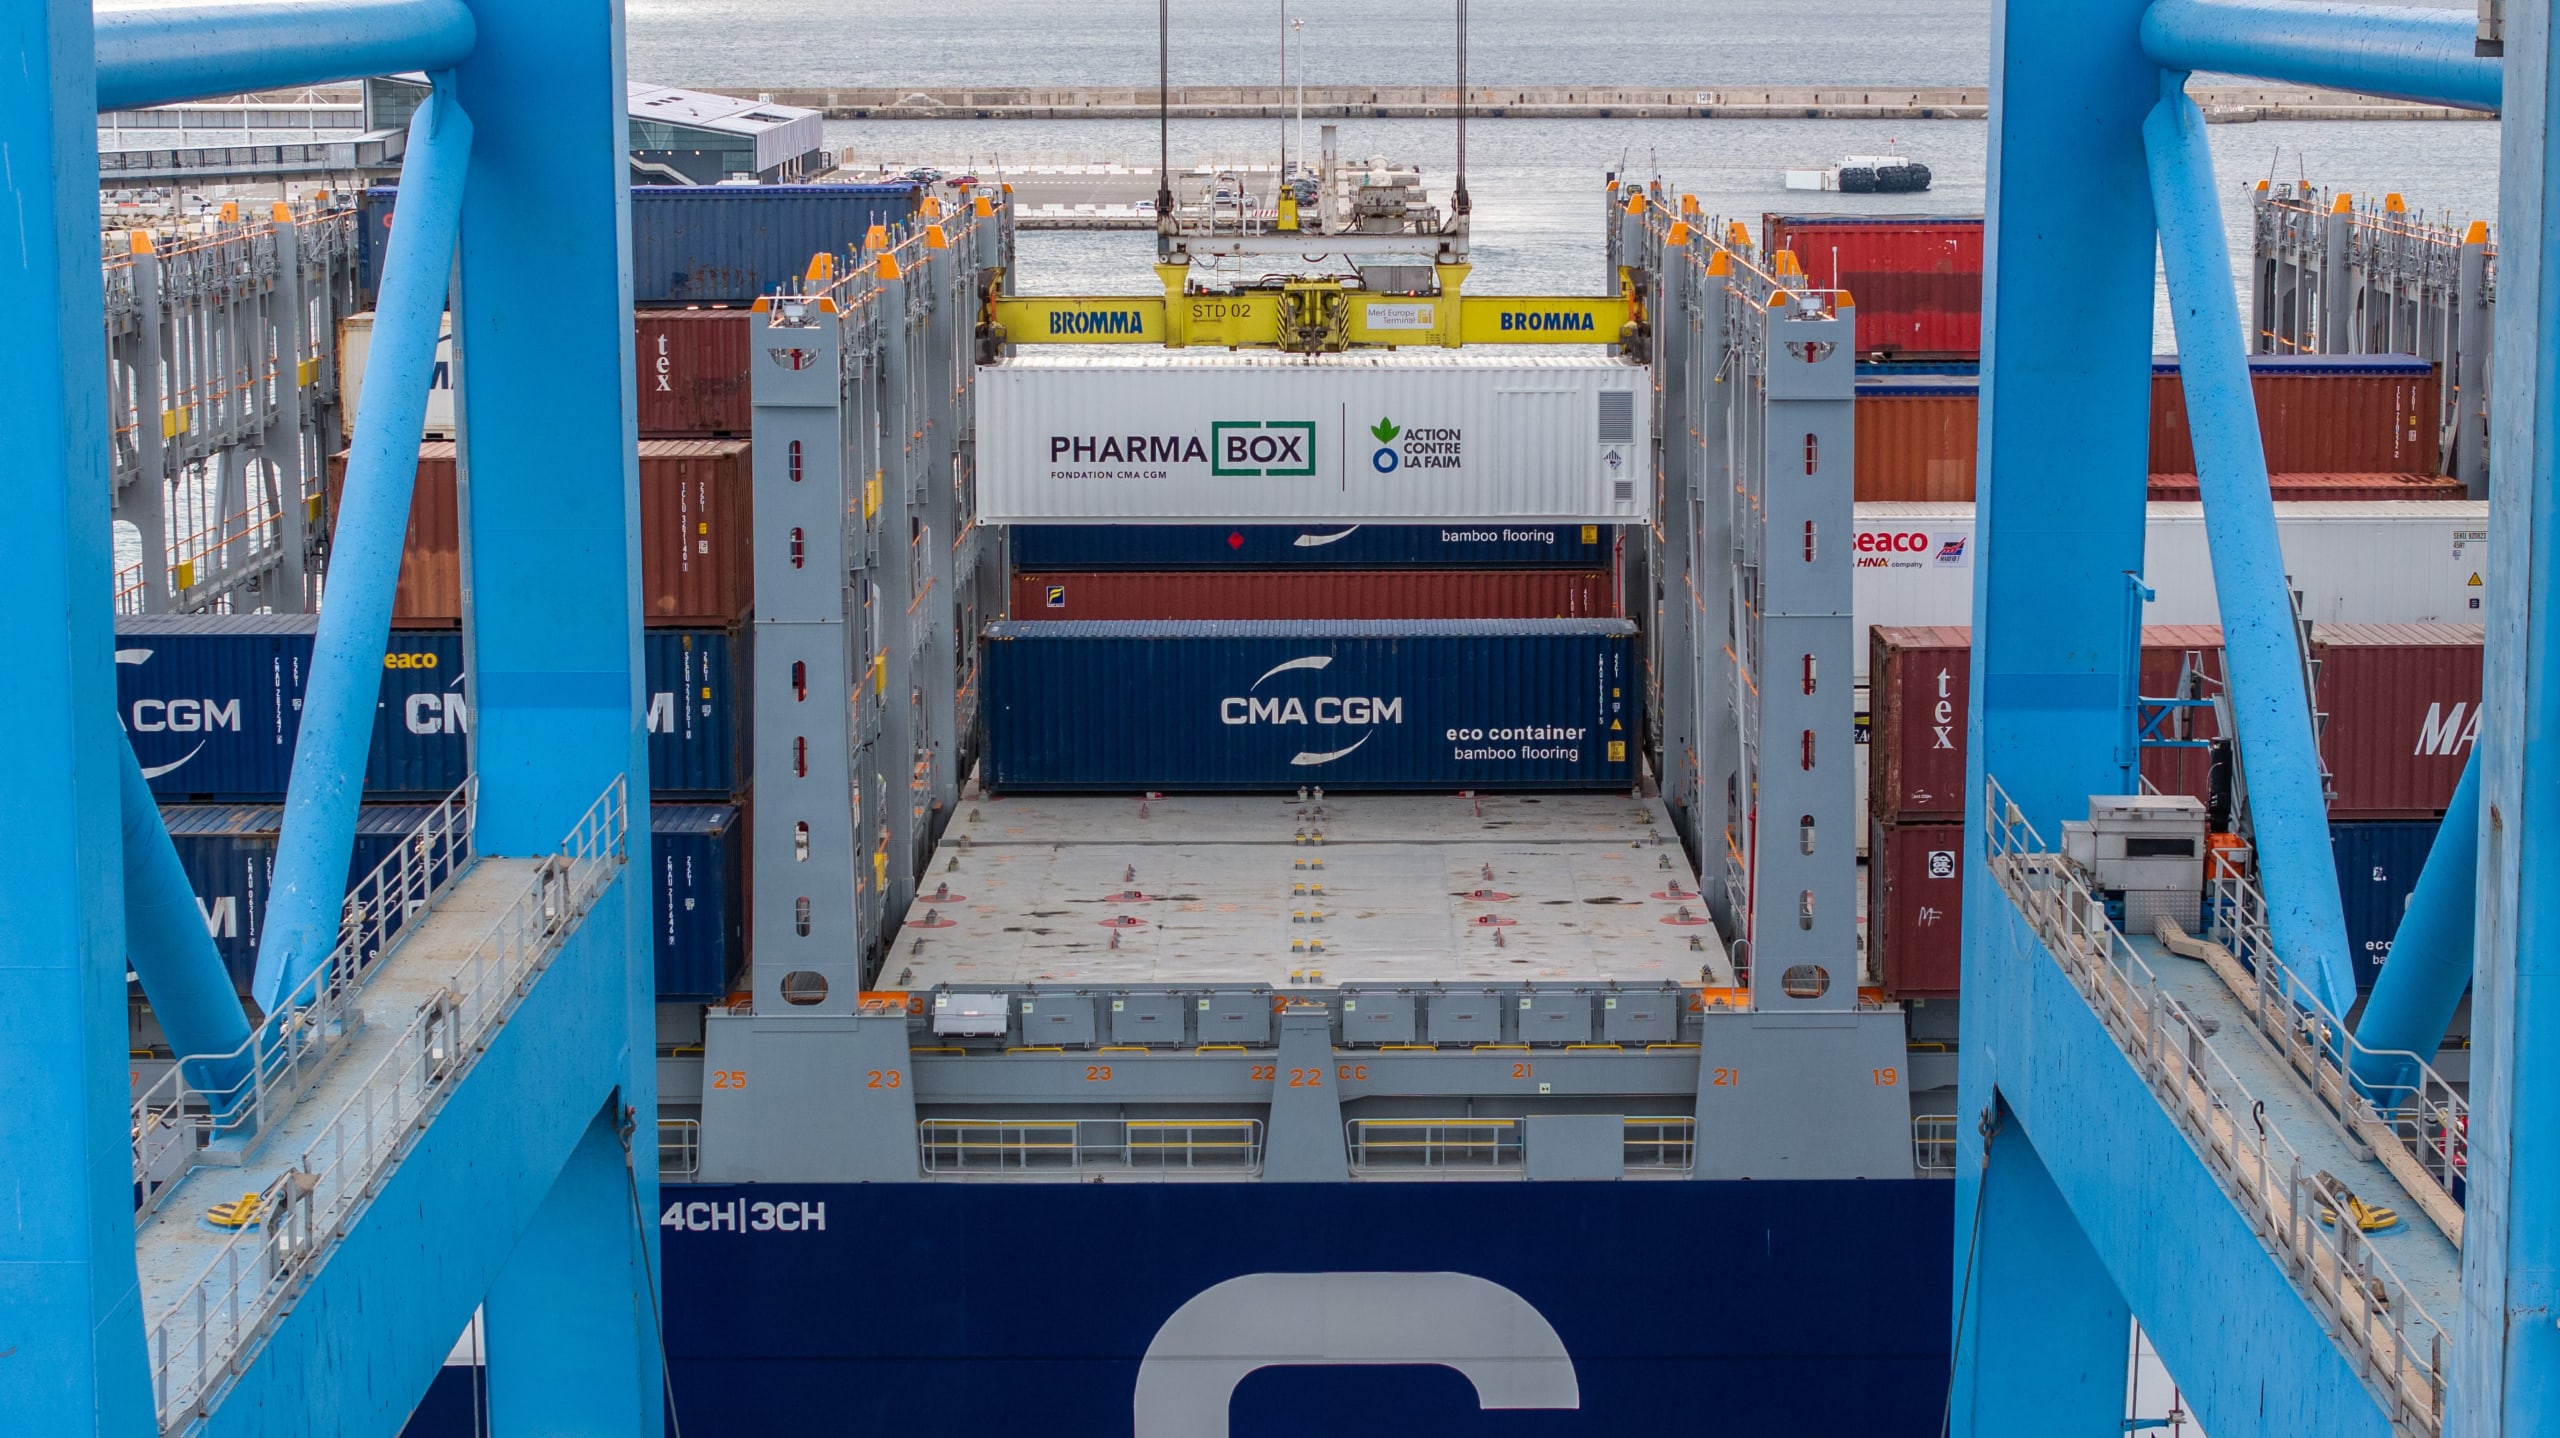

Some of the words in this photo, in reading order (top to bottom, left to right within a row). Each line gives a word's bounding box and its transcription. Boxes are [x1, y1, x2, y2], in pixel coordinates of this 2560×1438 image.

[1192, 303, 1227, 318] STD
[1231, 303, 1251, 318] 02
[1387, 308, 1416, 318] Europe
[1050, 311, 1143, 334] BROMMA
[1383, 316, 1416, 325] Terminal
[1501, 312, 1594, 330] BROMMA
[656, 334, 672, 392] tex
[1404, 429, 1461, 441] ACTION
[1051, 436, 1208, 462] PHARMA
[1227, 435, 1302, 463] BOX
[1403, 442, 1461, 454] CONTRE
[1404, 456, 1422, 468] LA
[1424, 456, 1461, 468] FAIM
[1051, 471, 1113, 479] FONDATION
[1117, 471, 1140, 479] CMA
[1143, 471, 1167, 479] CGM
[1442, 530, 1498, 541] bamboo
[1503, 529, 1554, 544] flooring
[1857, 557, 1890, 568] HNA
[384, 653, 438, 668] eaco
[133, 699, 241, 731] CGM
[406, 693, 467, 734] CM
[1221, 697, 1308, 724] CMA
[1315, 697, 1402, 724] CGM
[1932, 668, 1954, 749] tex
[1446, 727, 1483, 741] eco
[1488, 725, 1586, 741] container
[1454, 747, 1516, 760] bamboo
[1521, 746, 1579, 762] flooring
[1086, 1066, 1112, 1081] 23
[1250, 1065, 1276, 1081] 22
[1289, 1068, 1322, 1087] 22
[1338, 1065, 1367, 1080] CC
[1512, 1063, 1533, 1078] 21
[1713, 1068, 1738, 1086] 21
[1872, 1067, 1897, 1086] 19
[712, 1071, 747, 1090] 25
[867, 1070, 902, 1089] 23
